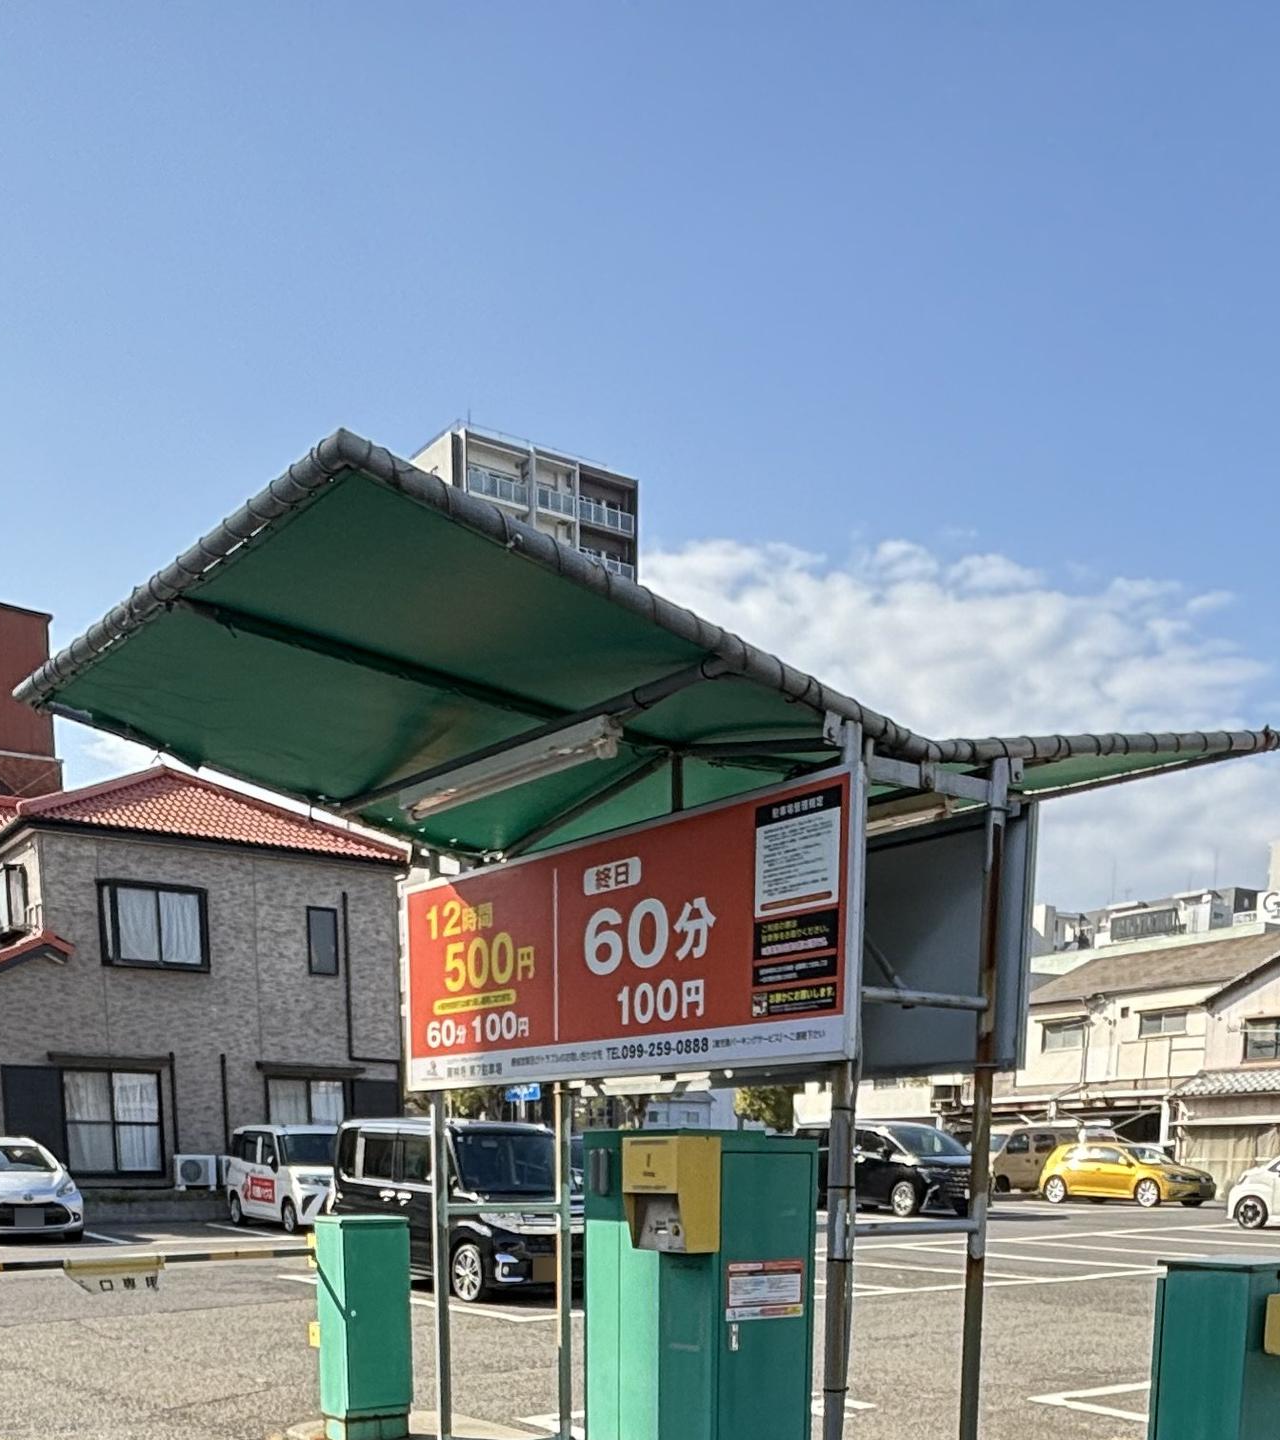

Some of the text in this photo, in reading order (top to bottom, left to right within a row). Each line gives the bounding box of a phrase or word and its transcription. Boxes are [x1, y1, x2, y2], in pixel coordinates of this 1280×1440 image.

[426, 900, 494, 941] 12時間
[583, 897, 717, 977] 60分
[444, 931, 536, 992] 500円
[616, 978, 706, 1026] 100円
[426, 1011, 529, 1048] 60分 100円
